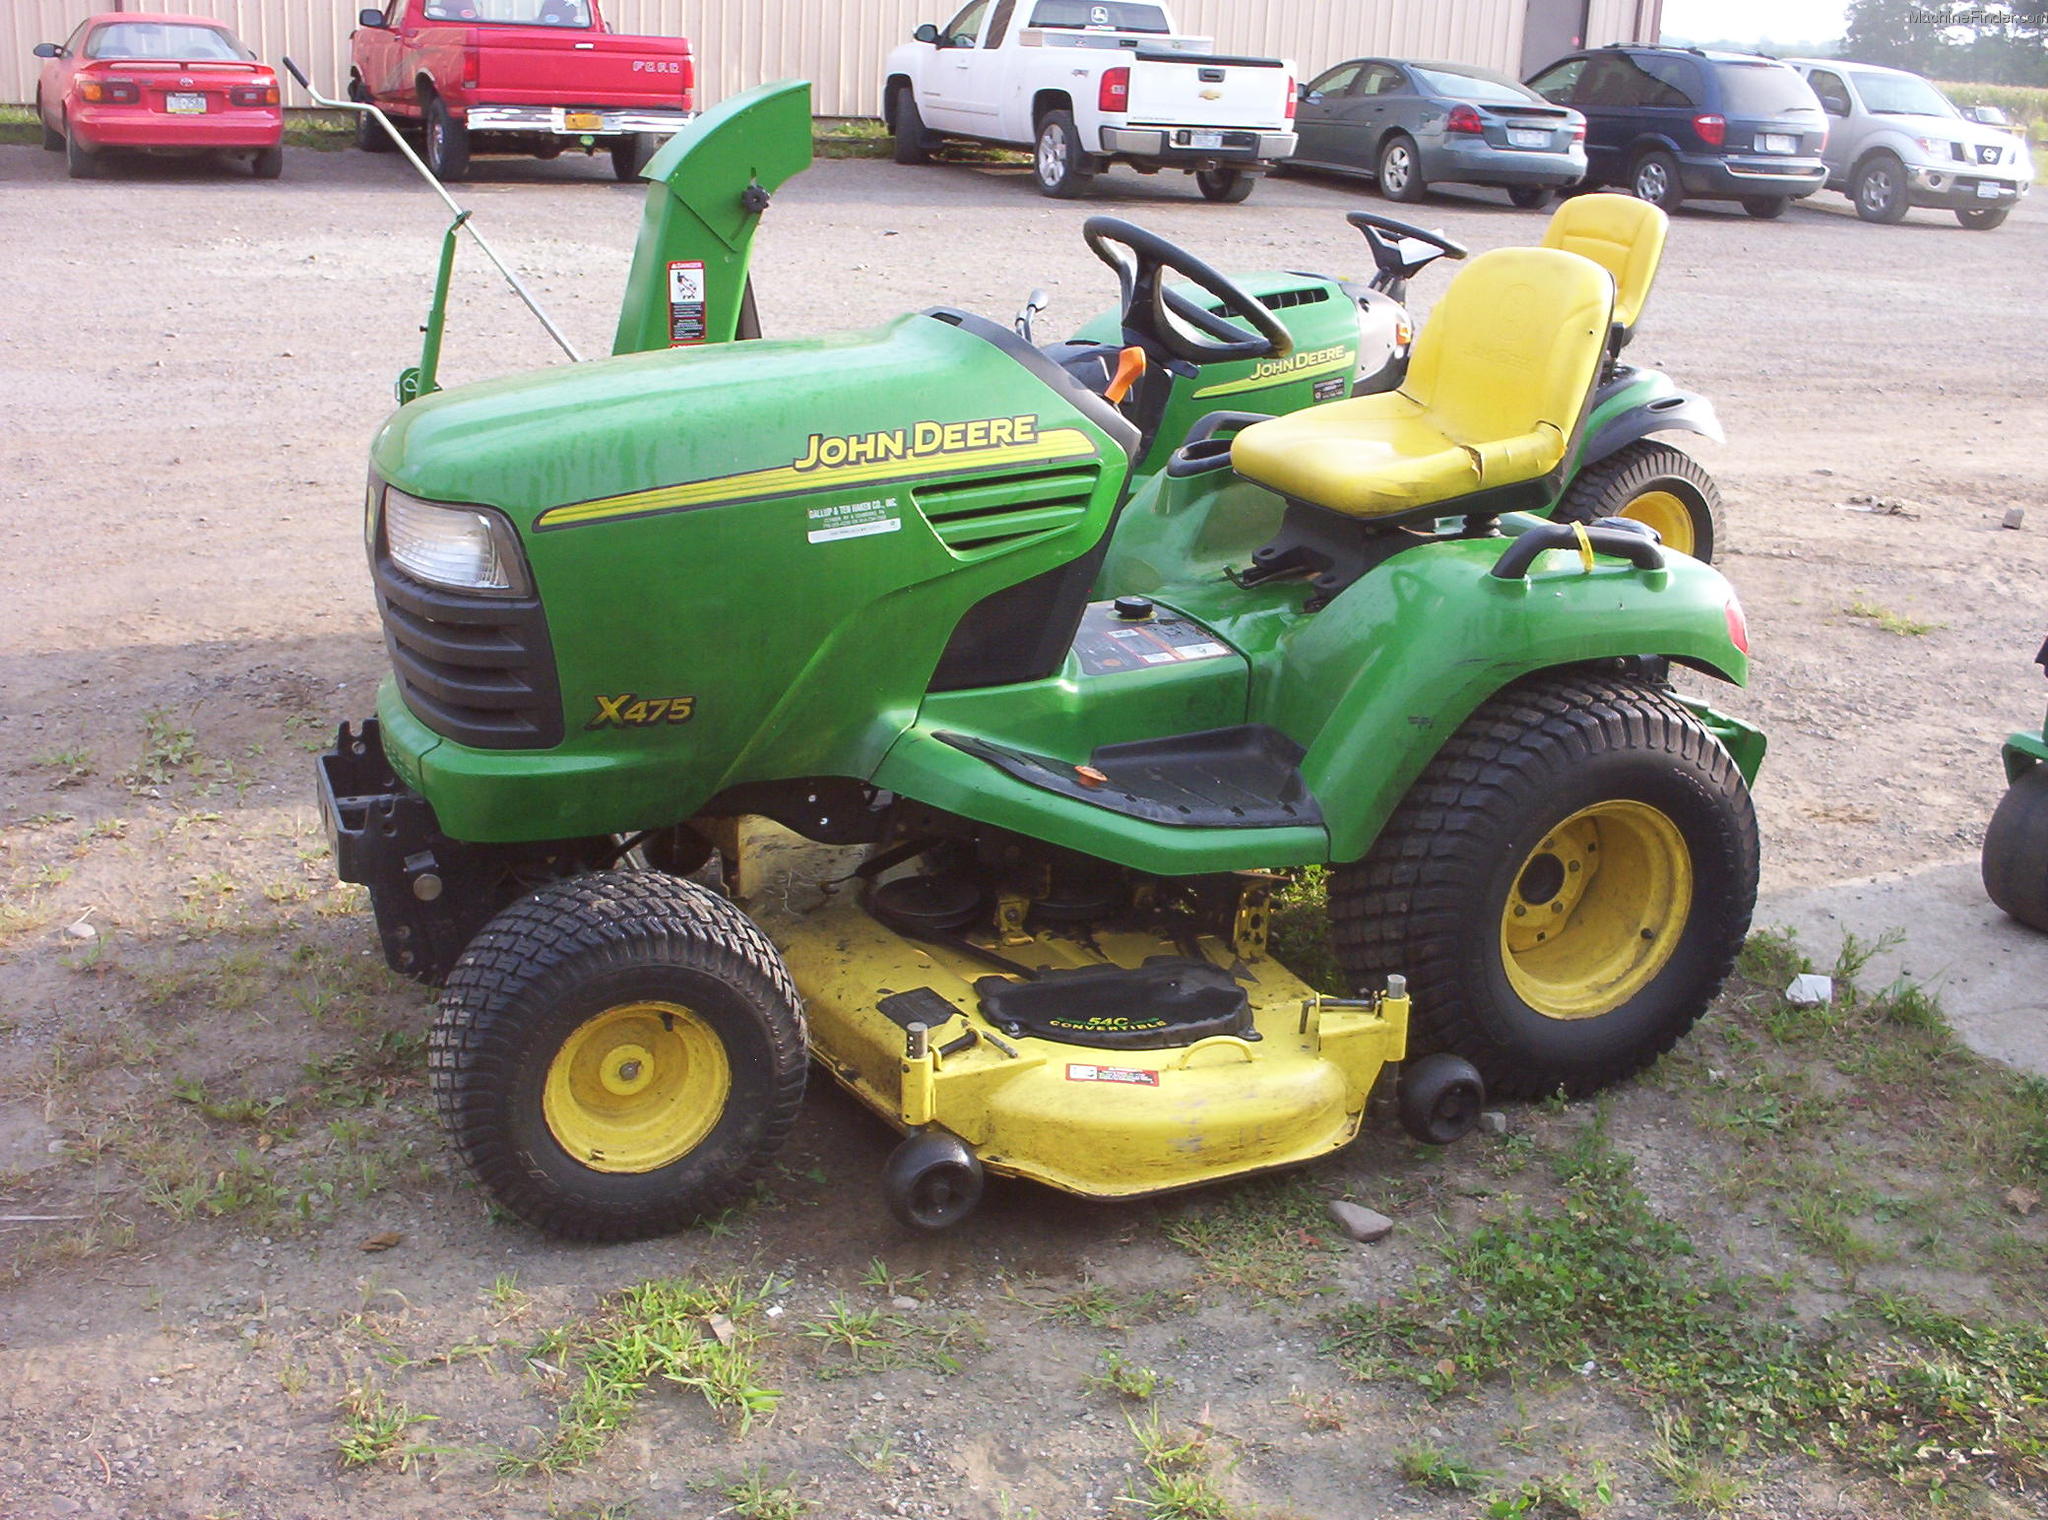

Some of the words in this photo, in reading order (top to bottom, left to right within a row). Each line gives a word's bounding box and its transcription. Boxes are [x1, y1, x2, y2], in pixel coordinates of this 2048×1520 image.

[632, 60, 680, 74] FORD
[1250, 357, 1294, 381] JOHN
[1295, 344, 1345, 369] DEERE
[793, 429, 907, 472] JOHN
[912, 414, 1038, 457] DEERE
[587, 693, 696, 727] X475
[1049, 1019, 1169, 1031] CONVERTIBLE
[1088, 1017, 1129, 1027] 54C
